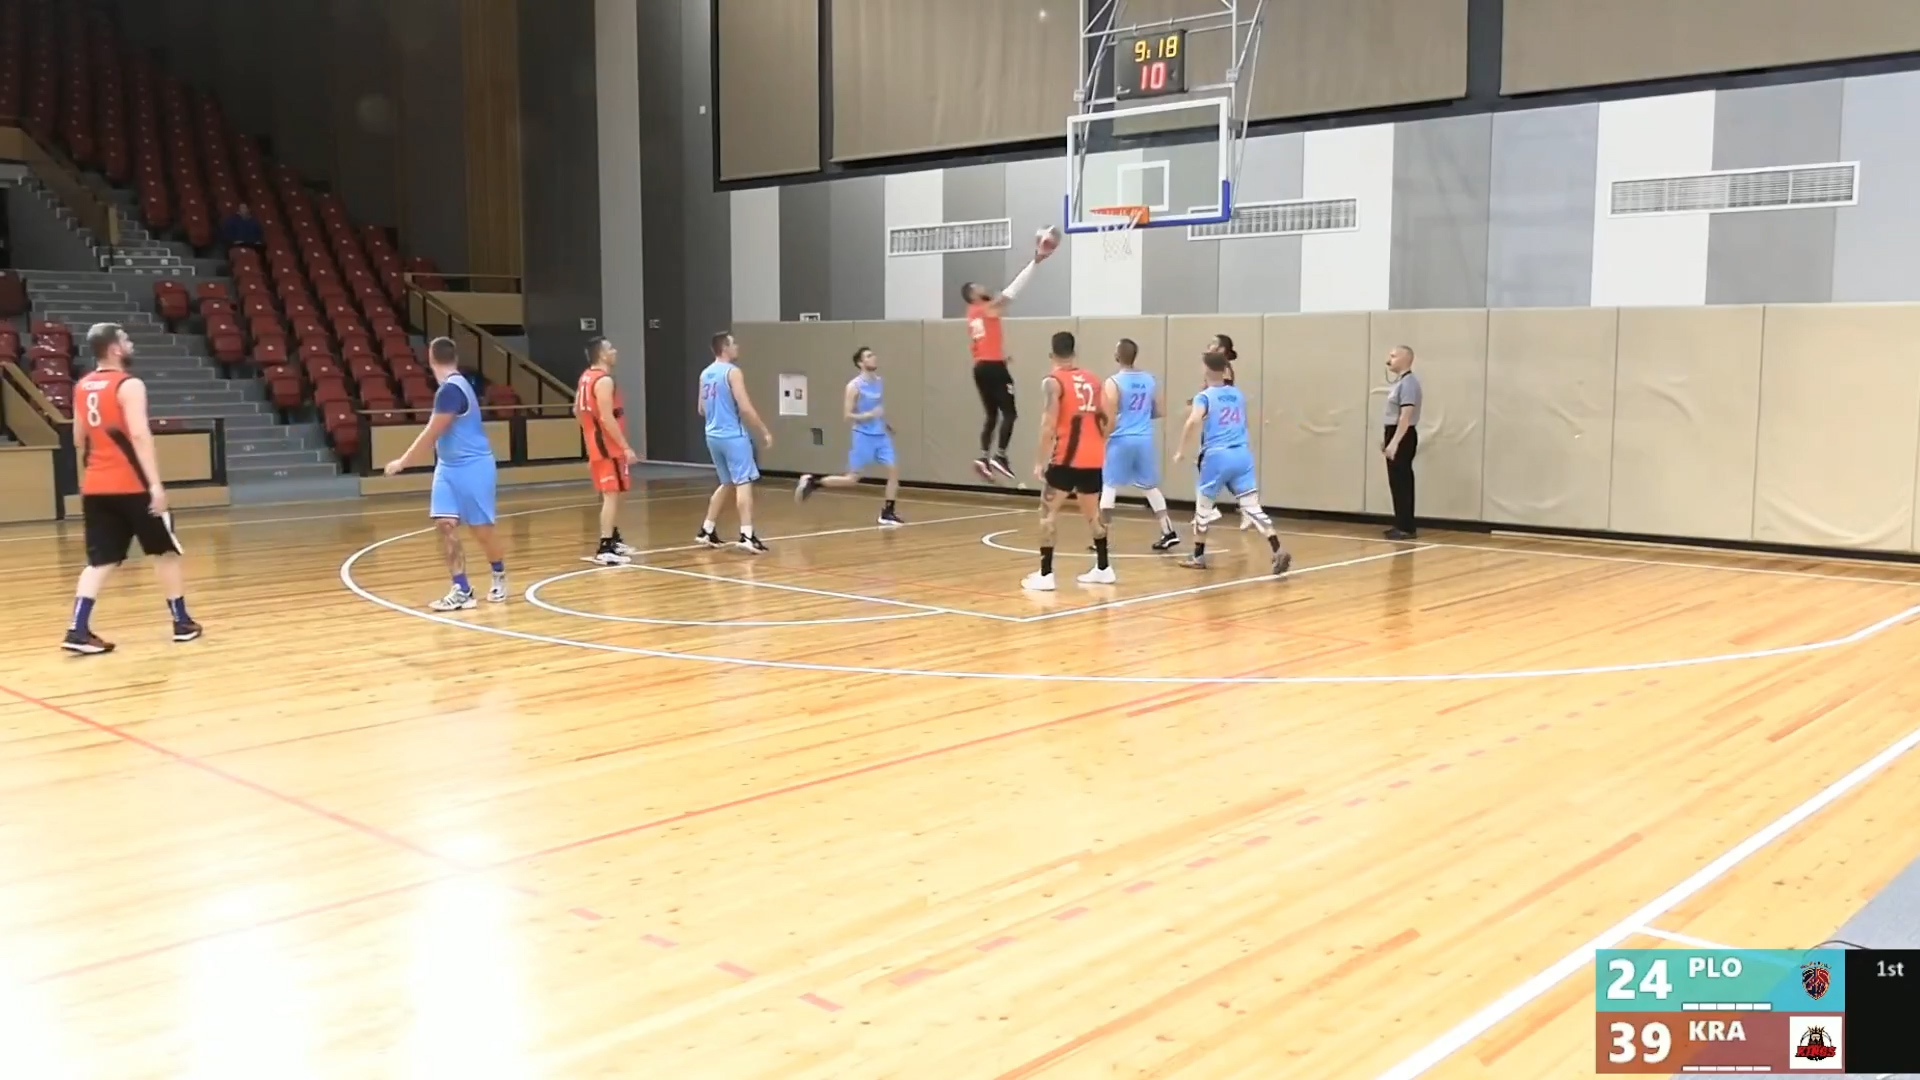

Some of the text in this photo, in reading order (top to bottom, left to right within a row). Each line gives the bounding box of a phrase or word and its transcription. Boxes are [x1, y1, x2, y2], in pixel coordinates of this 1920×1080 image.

[1134, 35, 1178, 63] 9:18
[1141, 61, 1165, 90] 10
[86, 391, 102, 428] 8
[1074, 382, 1096, 412] 52
[1128, 392, 1146, 411] 21
[1218, 406, 1241, 425] 24
